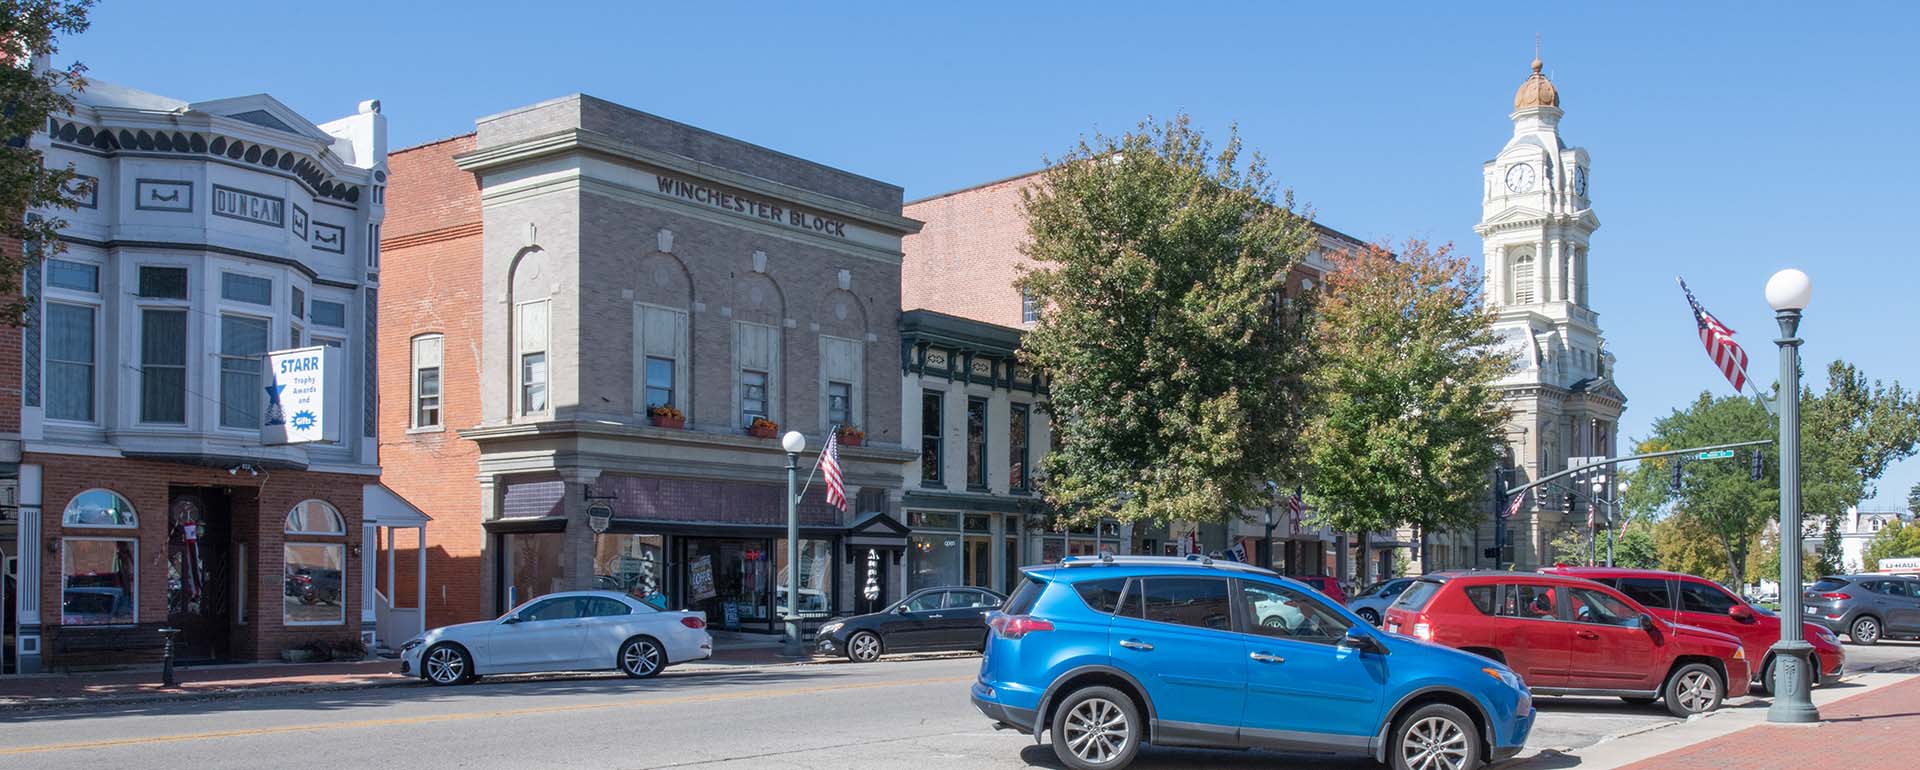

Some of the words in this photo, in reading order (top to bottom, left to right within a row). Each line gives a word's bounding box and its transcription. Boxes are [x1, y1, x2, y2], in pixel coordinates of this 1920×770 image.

[656, 175, 783, 223] WINCHESTER
[789, 207, 846, 238] BLOCK
[281, 356, 319, 374] STARR
[294, 377, 315, 385] Trophy
[299, 396, 310, 404] and
